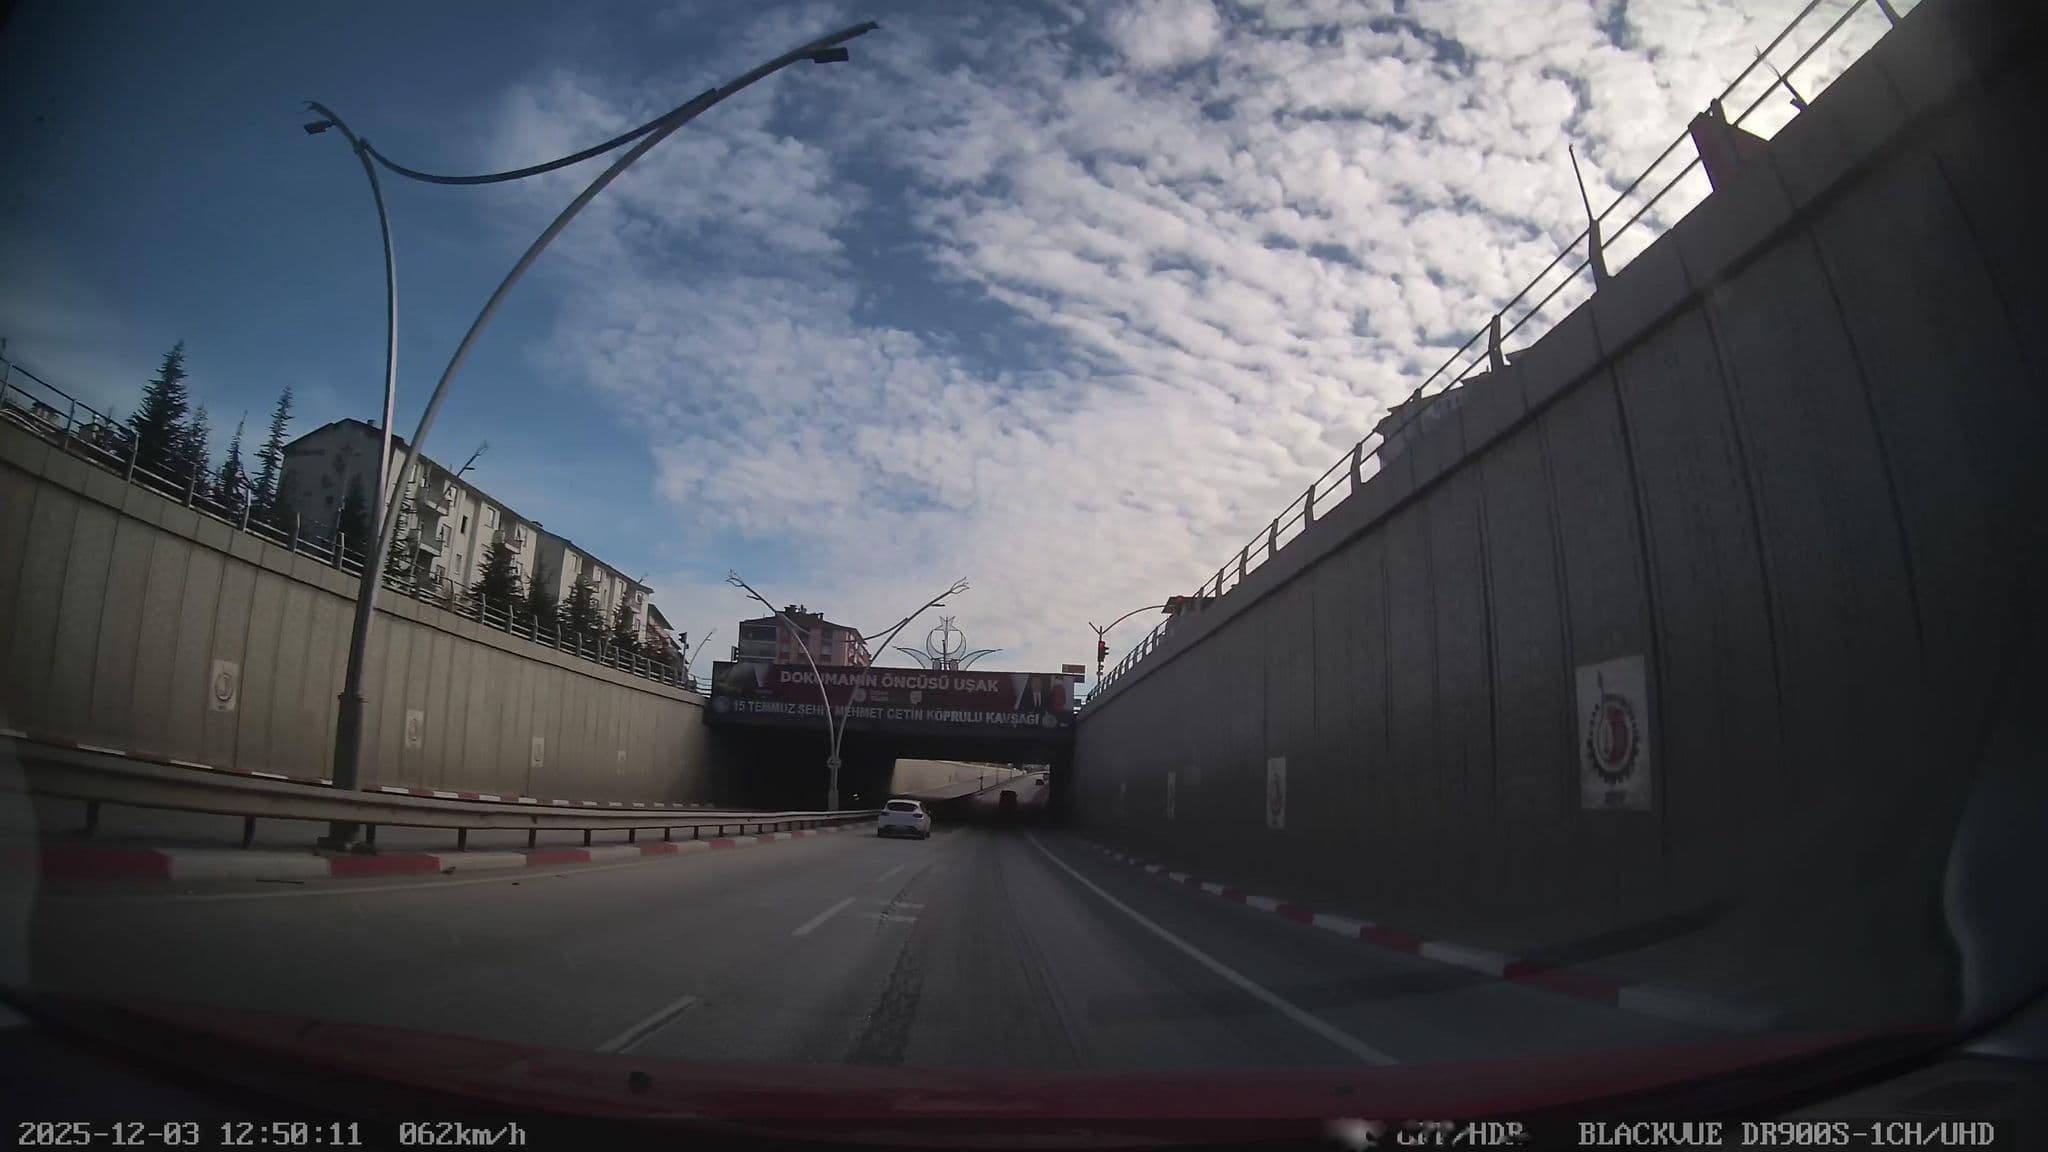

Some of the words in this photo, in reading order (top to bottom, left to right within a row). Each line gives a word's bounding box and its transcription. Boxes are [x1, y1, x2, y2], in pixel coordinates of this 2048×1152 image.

[881, 673, 950, 690] ÖNCÜSÜ
[953, 678, 999, 693] UŞAK
[733, 700, 746, 712] 15
[747, 701, 796, 714] TEMMUZ
